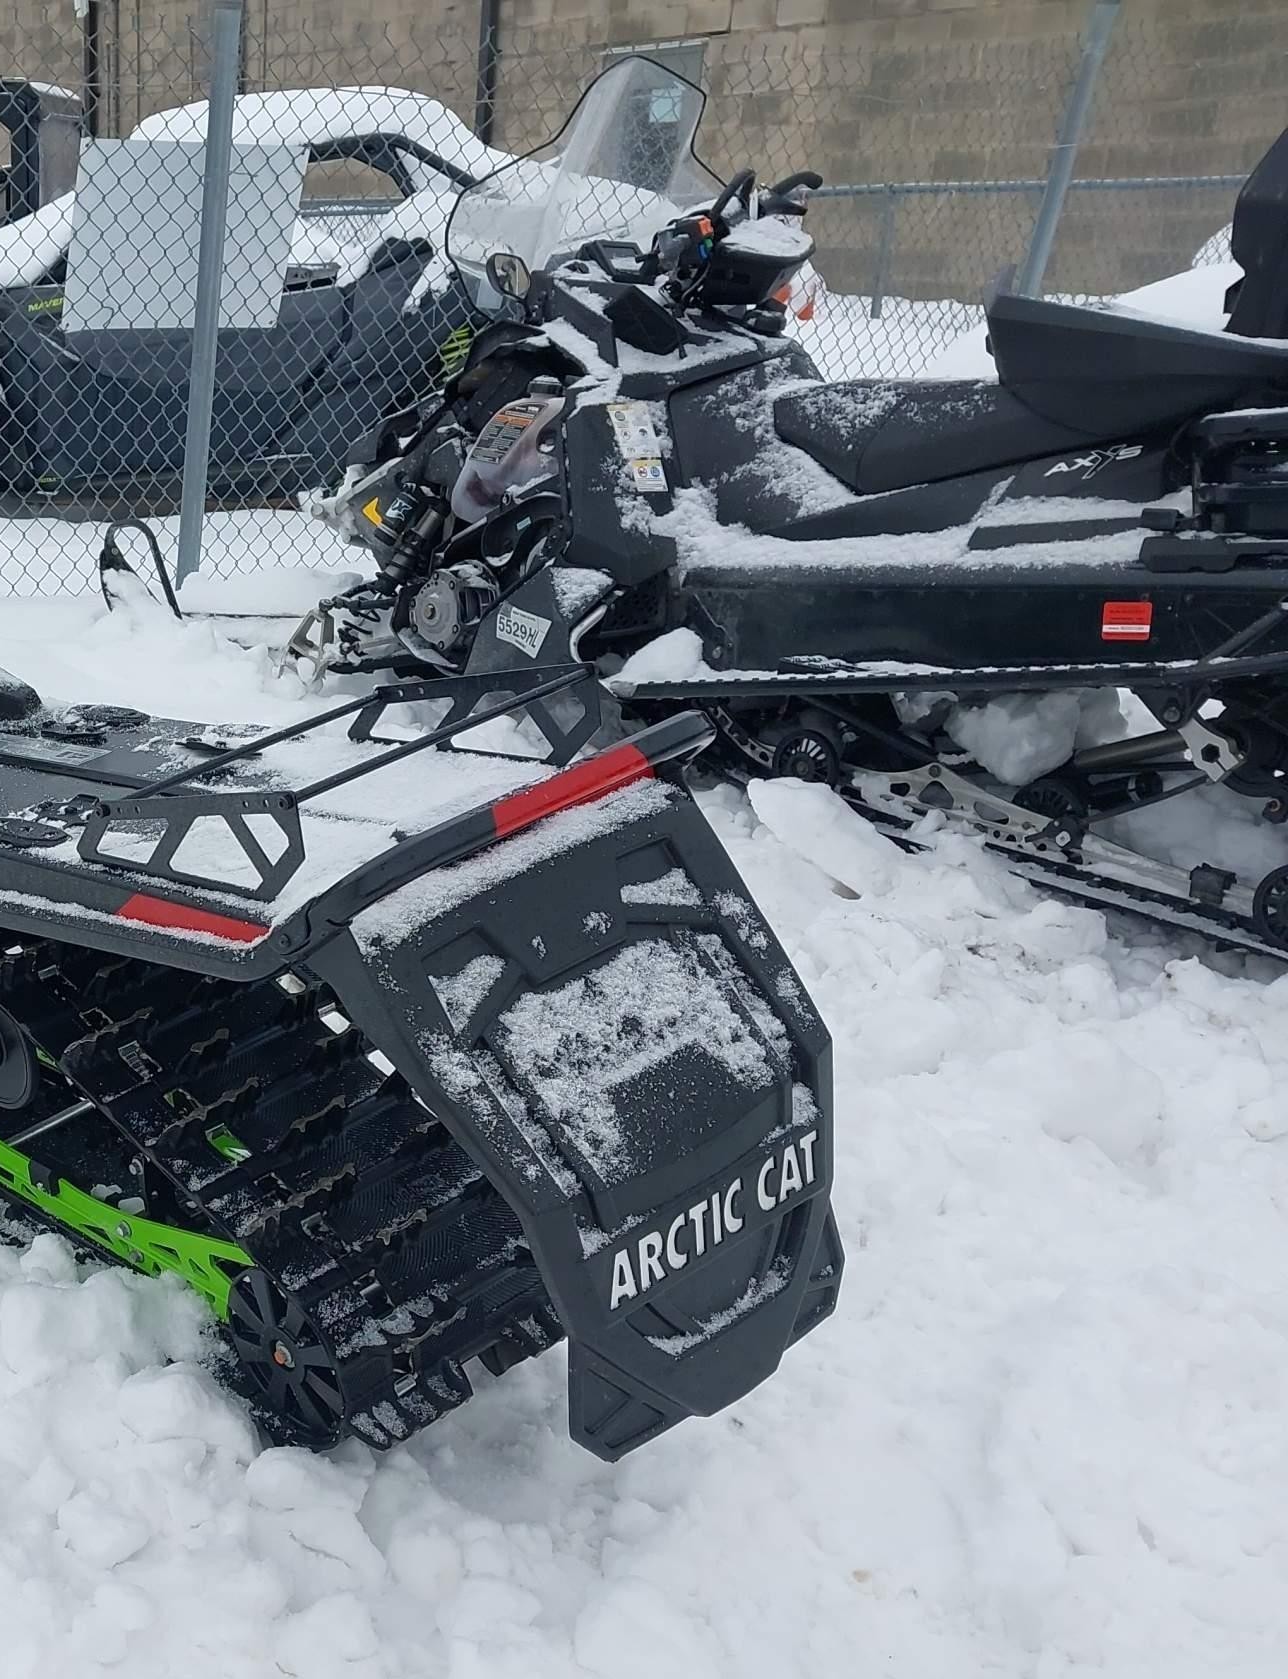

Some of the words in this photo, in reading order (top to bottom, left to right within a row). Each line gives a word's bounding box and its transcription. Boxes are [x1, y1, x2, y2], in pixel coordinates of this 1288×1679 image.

[1043, 444, 1144, 480] AXYS
[498, 615, 540, 649] 5529HL
[610, 1177, 745, 1311] ARCTIC
[757, 1129, 817, 1212] CAT
